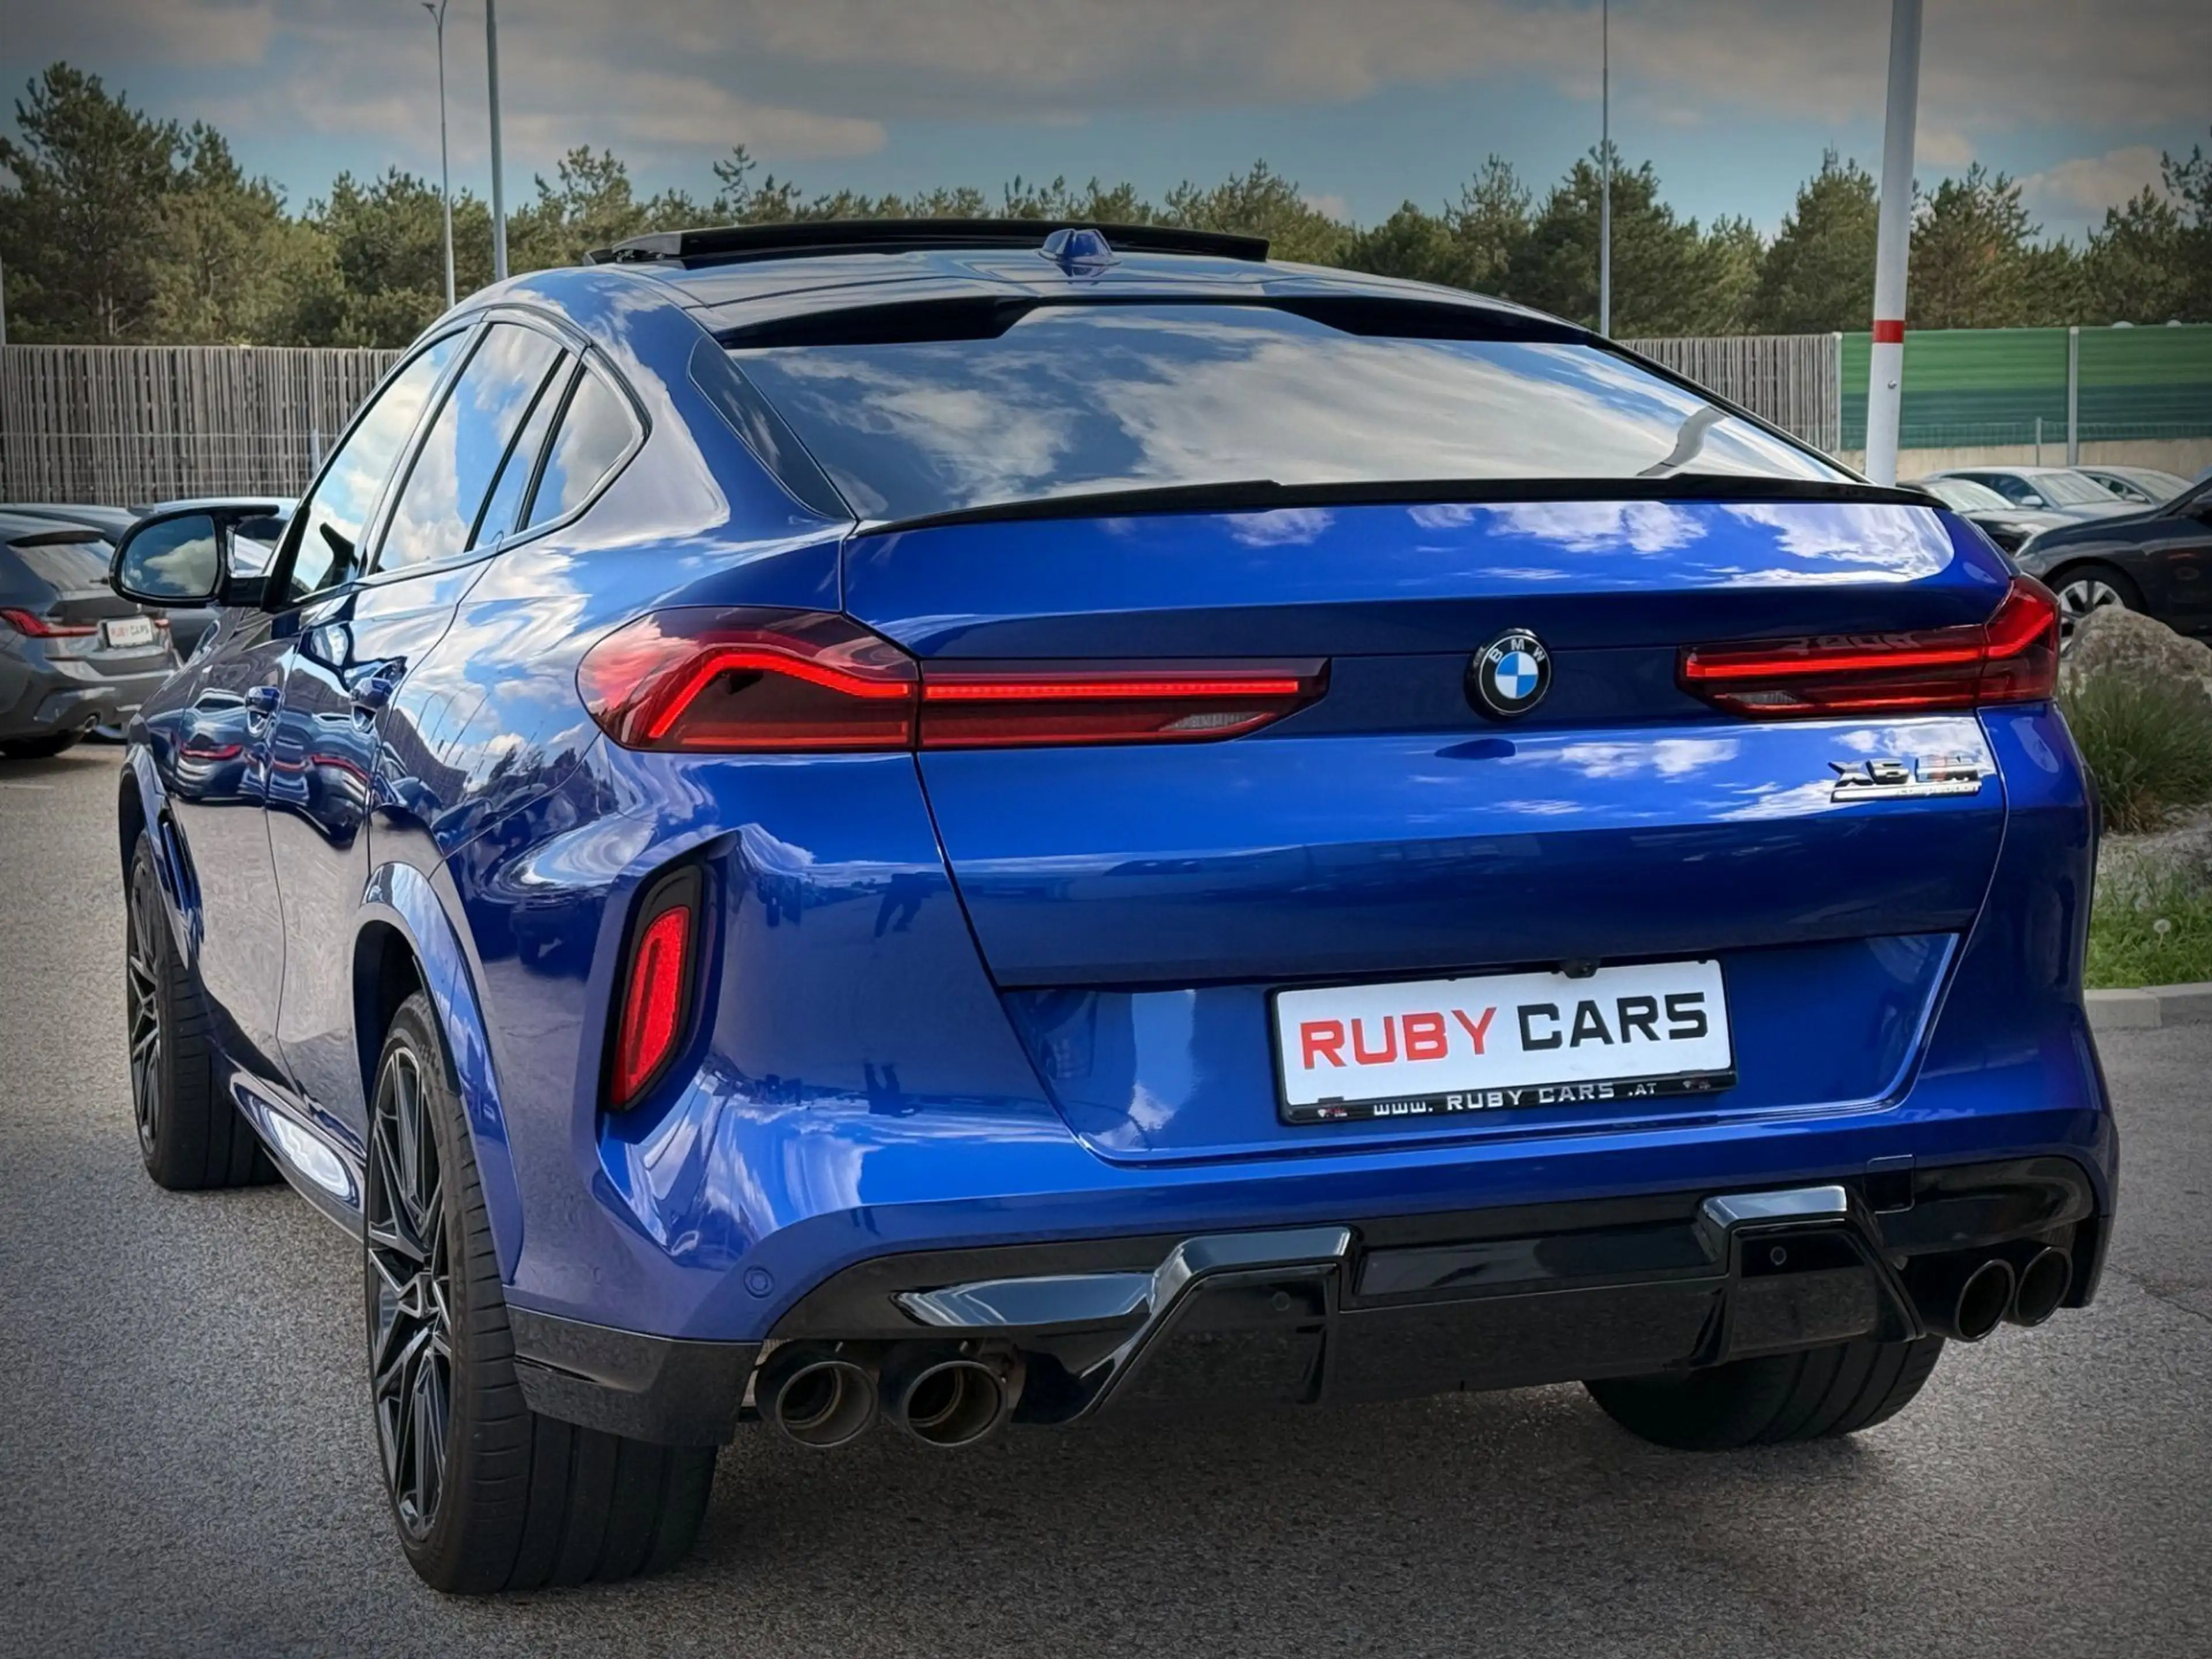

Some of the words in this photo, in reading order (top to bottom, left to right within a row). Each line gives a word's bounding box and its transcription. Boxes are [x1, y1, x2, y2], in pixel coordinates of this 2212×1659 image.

[1488, 638, 1546, 663] BMW
[1300, 1006, 1497, 1070] RUBY
[1517, 992, 1709, 1052] CARS
[1446, 1089, 1524, 1111] RUBY
[1539, 1082, 1615, 1104] CARS
